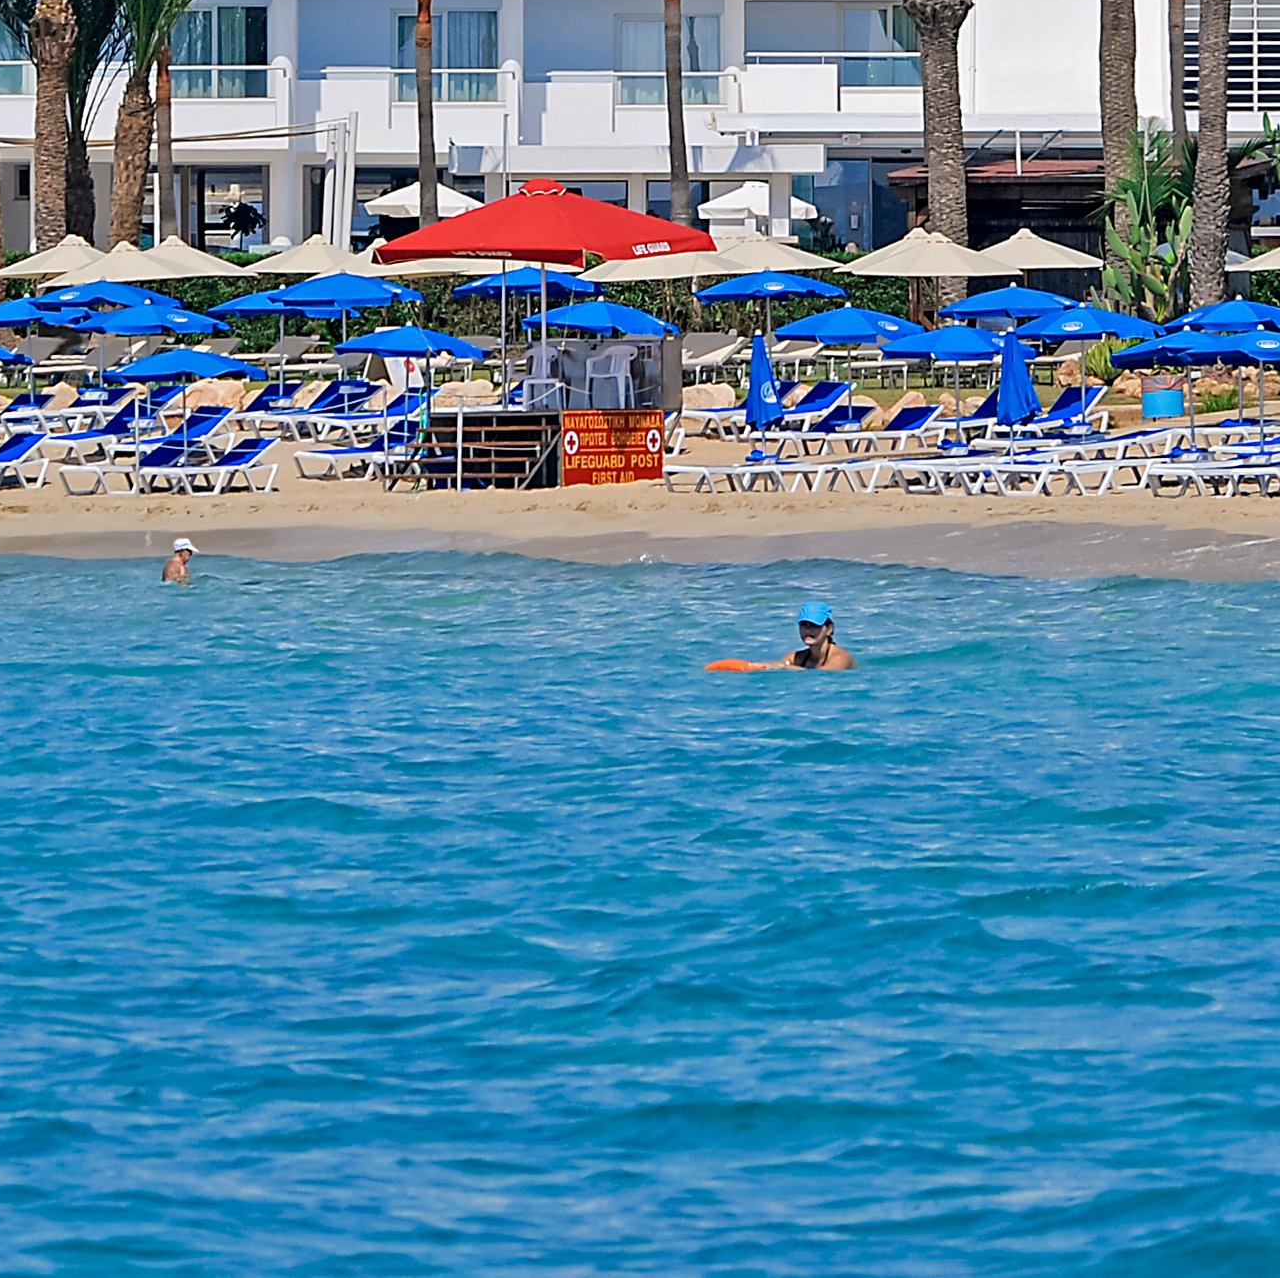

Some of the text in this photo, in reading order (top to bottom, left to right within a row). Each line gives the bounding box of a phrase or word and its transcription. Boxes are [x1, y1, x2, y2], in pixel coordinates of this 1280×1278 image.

[565, 454, 659, 469] LIFEGUARD POST
[592, 471, 635, 484] FIRST AID
